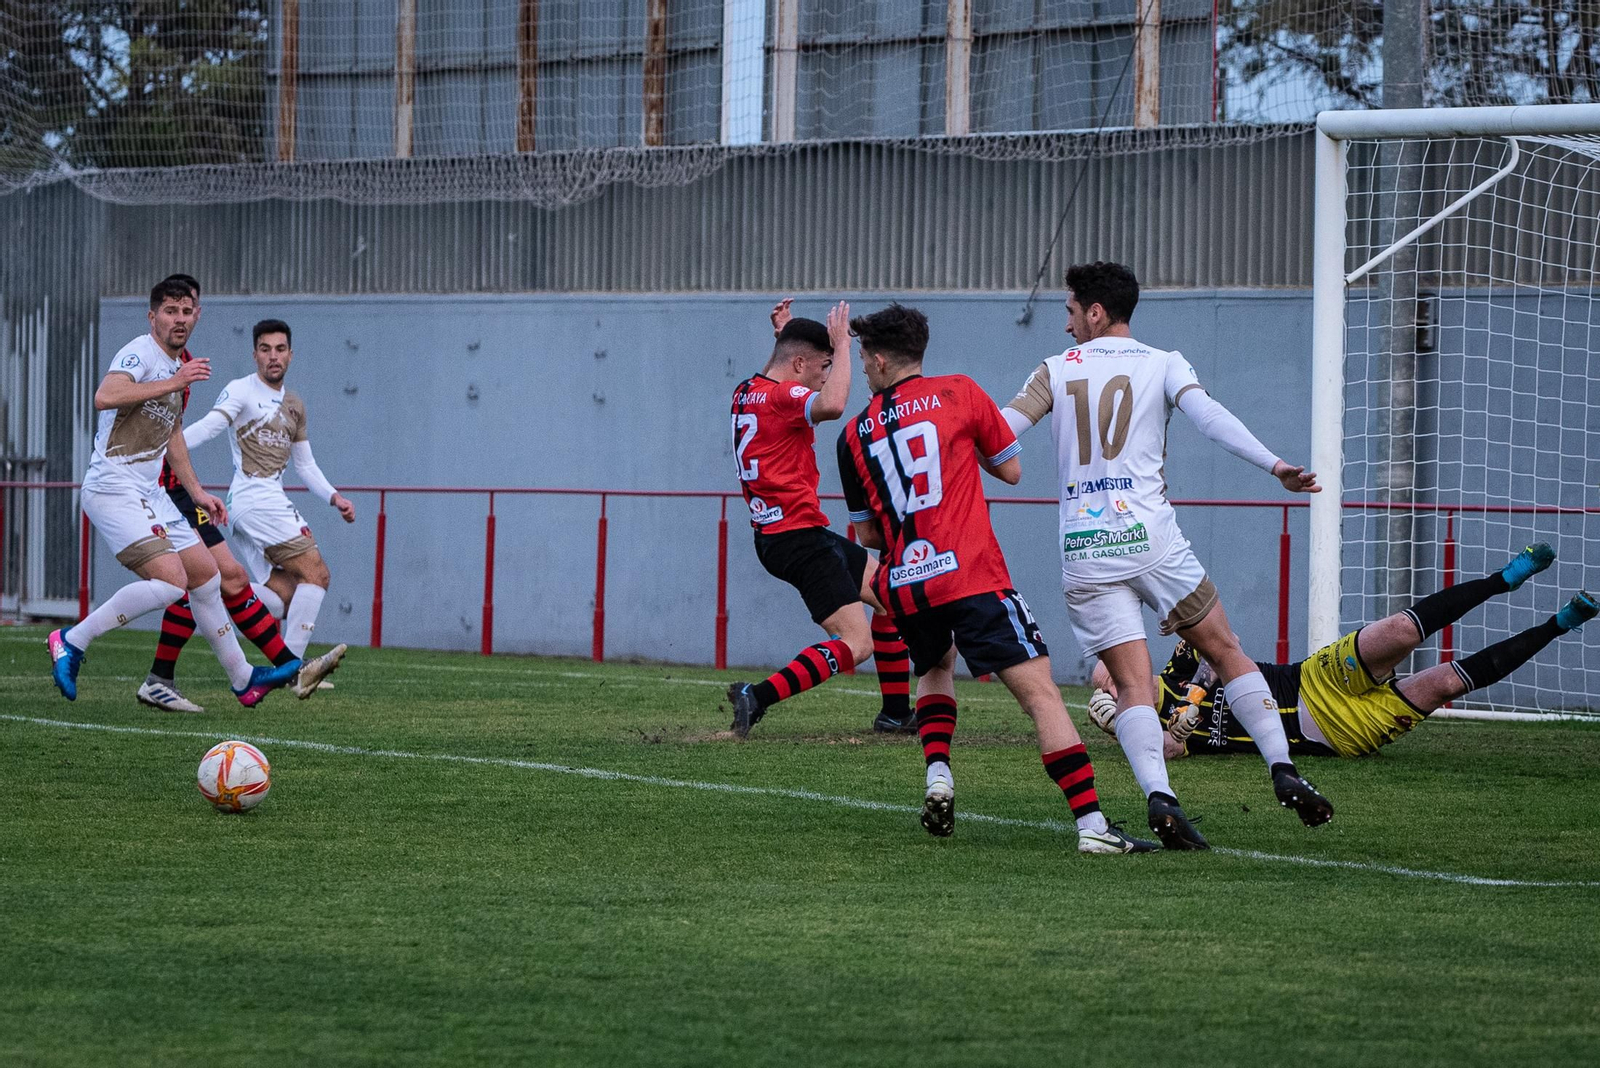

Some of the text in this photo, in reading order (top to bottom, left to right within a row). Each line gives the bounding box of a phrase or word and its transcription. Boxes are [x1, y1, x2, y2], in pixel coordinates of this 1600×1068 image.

[858, 394, 942, 438] AD CARTAYA
[1065, 374, 1134, 466] 10
[868, 420, 943, 522] 19
[140, 498, 157, 520] 5
[1065, 526, 1146, 550] Petro Markt
[1092, 543, 1151, 559] GASÓLEOS
